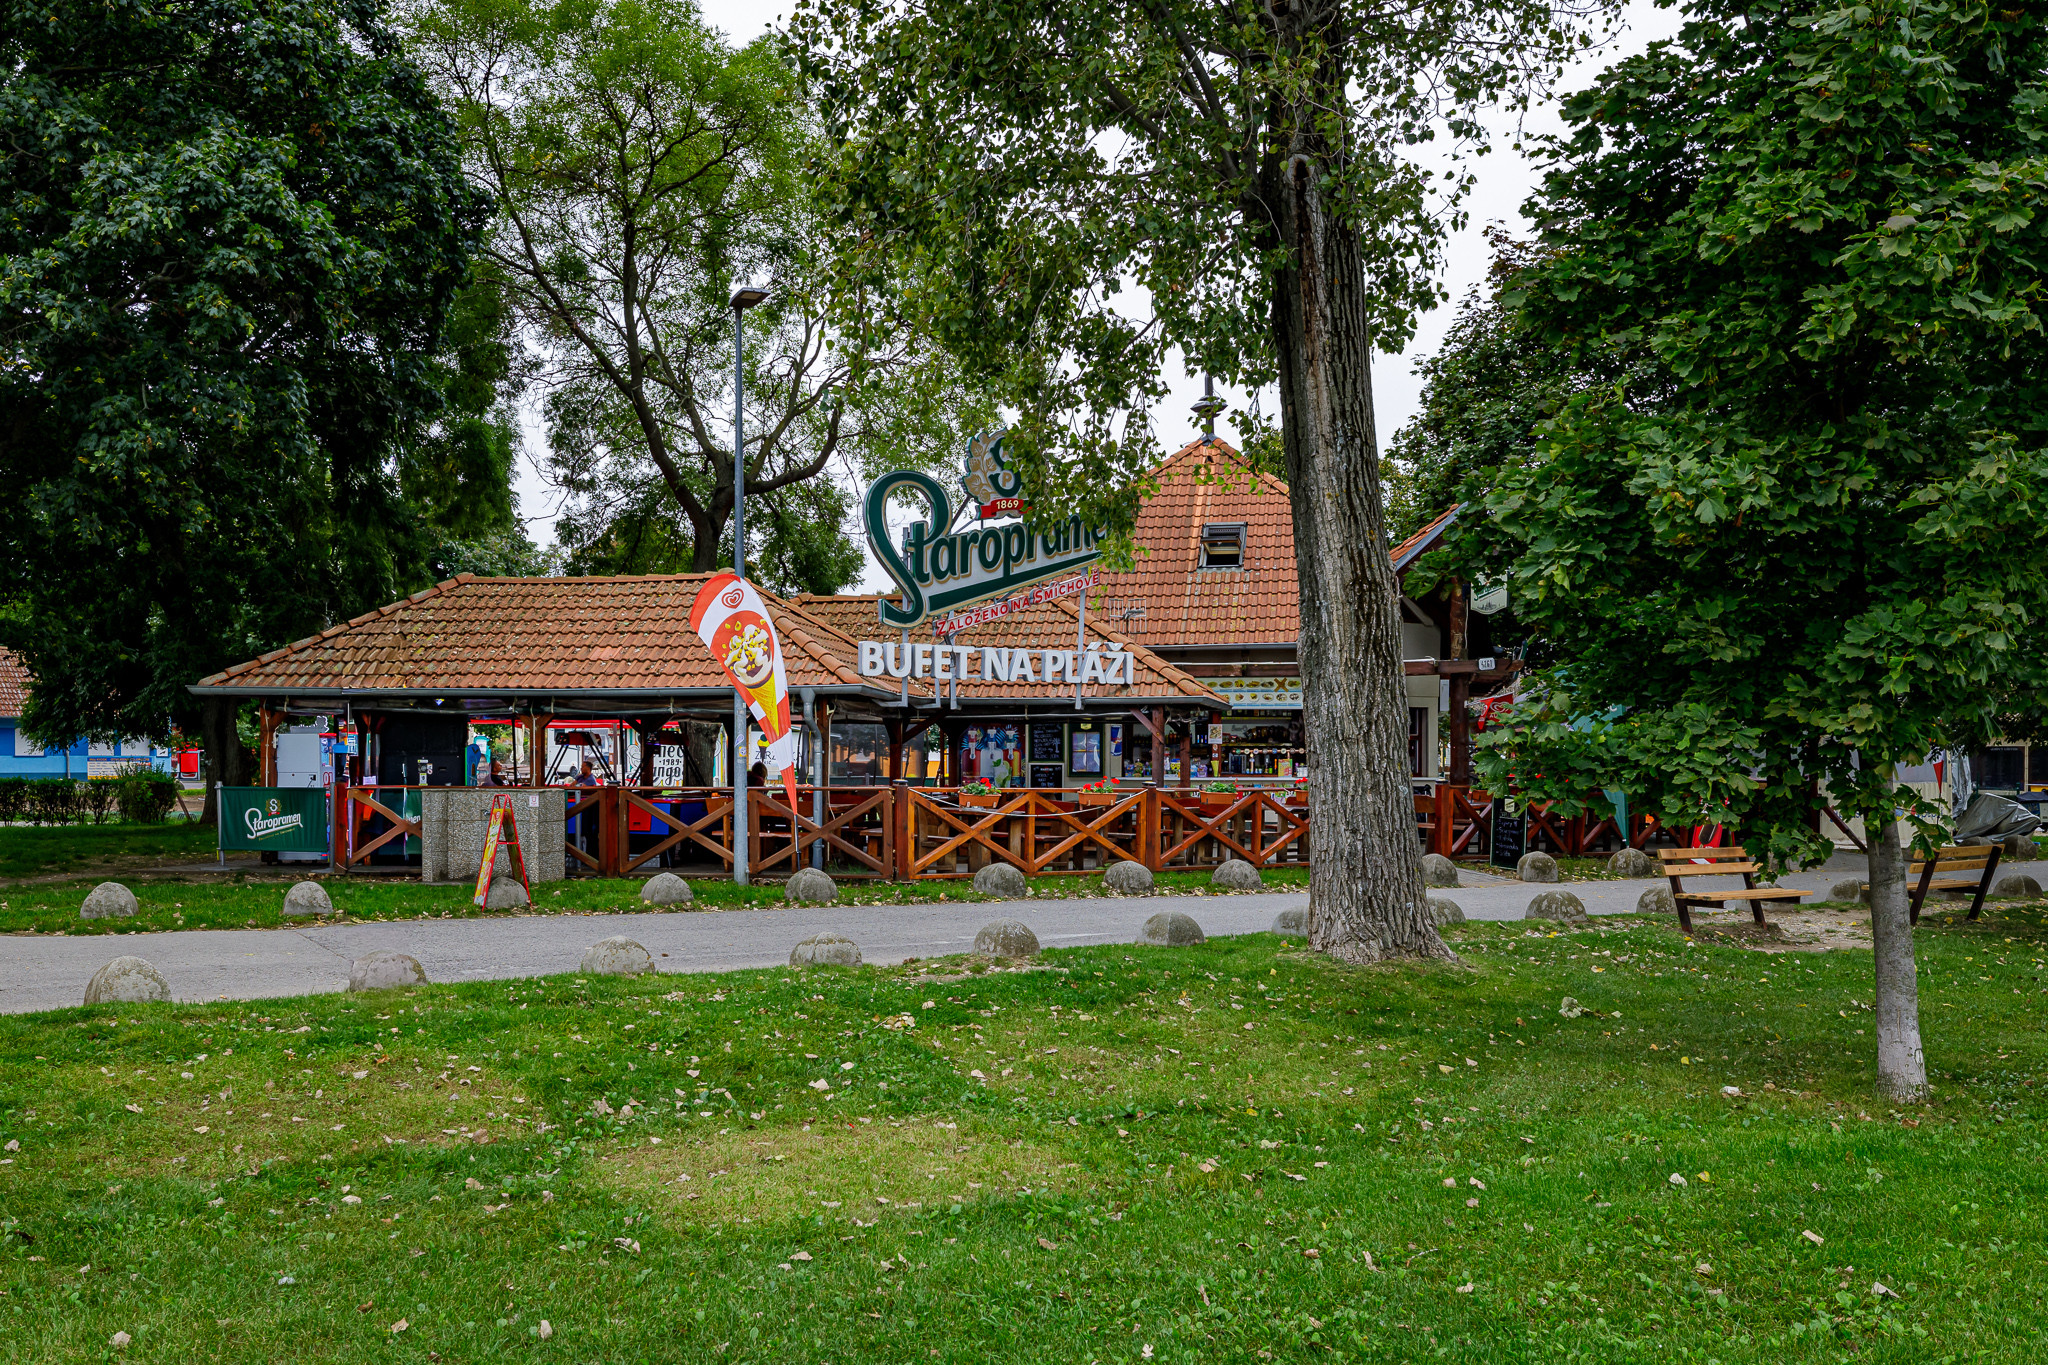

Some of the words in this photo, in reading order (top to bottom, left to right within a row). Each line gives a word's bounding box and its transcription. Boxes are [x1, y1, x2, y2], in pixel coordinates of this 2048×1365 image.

[996, 500, 1019, 511] 1869
[864, 470, 1110, 629] Staroprame
[1013, 596, 1031, 612] NA
[858, 641, 975, 679] BUFET
[981, 646, 1035, 682] NA
[1040, 641, 1134, 685] PLÁŽI
[269, 798, 278, 812] S
[244, 807, 304, 840] Staropramen
